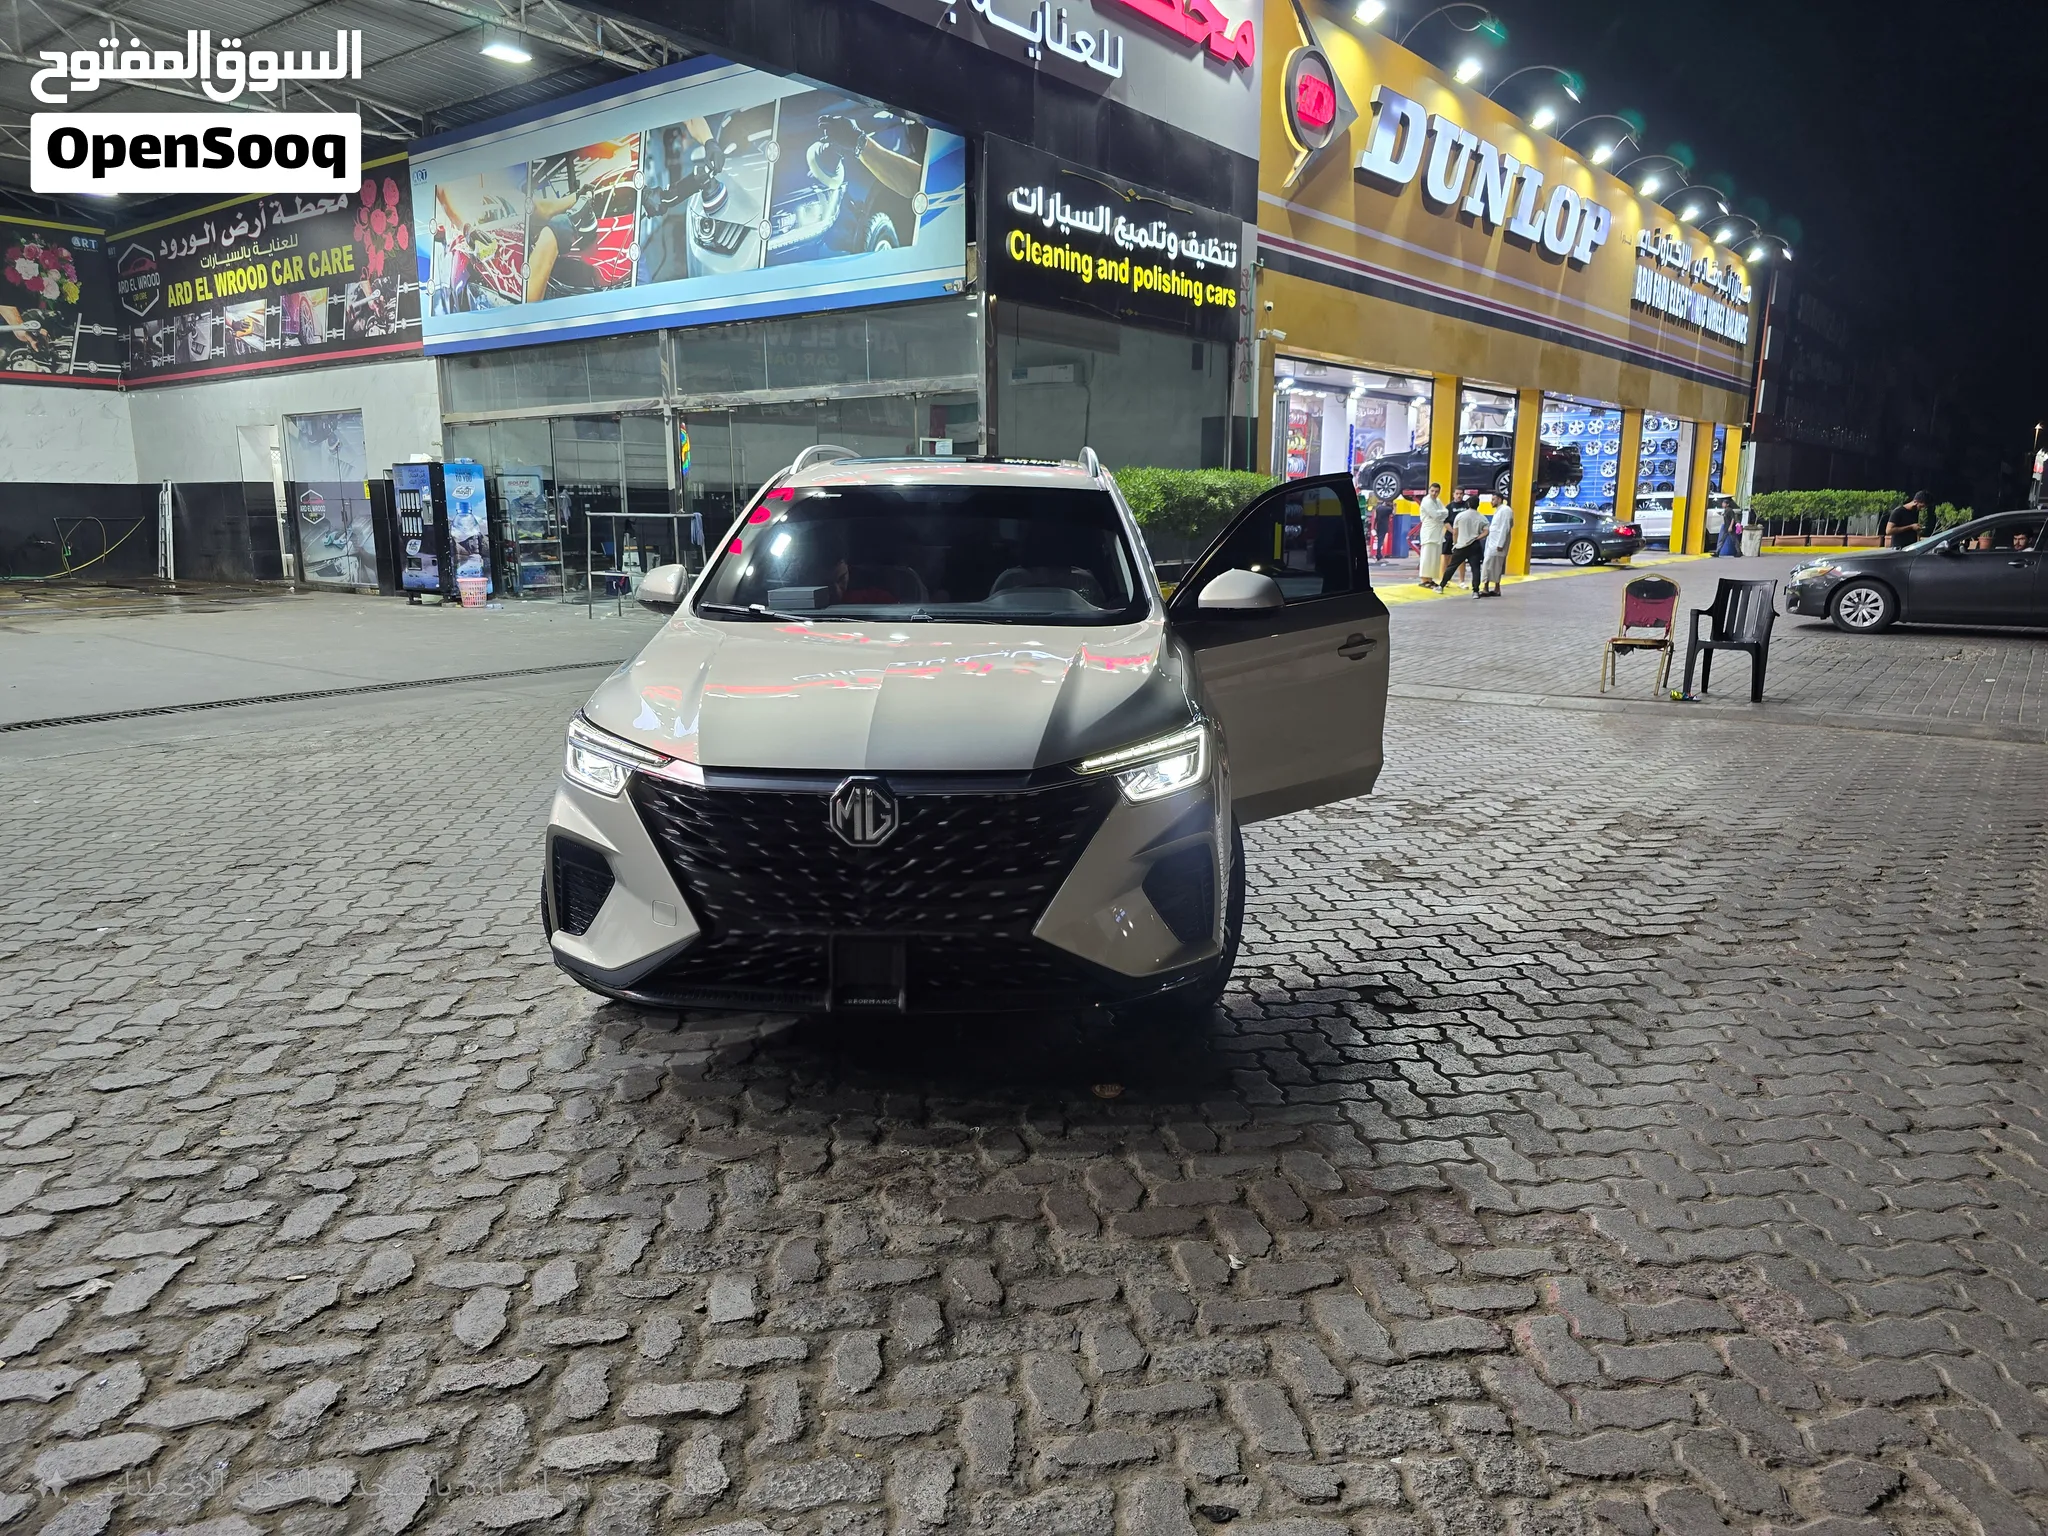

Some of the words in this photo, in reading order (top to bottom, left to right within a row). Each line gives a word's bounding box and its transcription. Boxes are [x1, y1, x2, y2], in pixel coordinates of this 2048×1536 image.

[1355, 84, 1613, 265] DUNLOP
[221, 200, 267, 247] أرض
[269, 193, 349, 225] محطة
[1008, 185, 1112, 236] السيارات
[159, 221, 216, 261] الورود
[200, 246, 251, 269] بالسيارات
[253, 233, 299, 257] للعناية
[1113, 215, 1178, 260] وتلميع
[1180, 231, 1238, 270] تنظيف
[118, 281, 130, 295] ARD
[137, 272, 161, 290] WROOD
[167, 280, 193, 308] ARD
[195, 276, 214, 301] EL
[213, 263, 268, 298] WROOD
[271, 255, 306, 286] CAR
[308, 245, 355, 278] CARE
[1008, 230, 1093, 284] Cleaning
[1097, 257, 1129, 284] and
[1133, 264, 1203, 307] polishing
[1206, 283, 1237, 308] cars
[836, 786, 892, 840] MG
